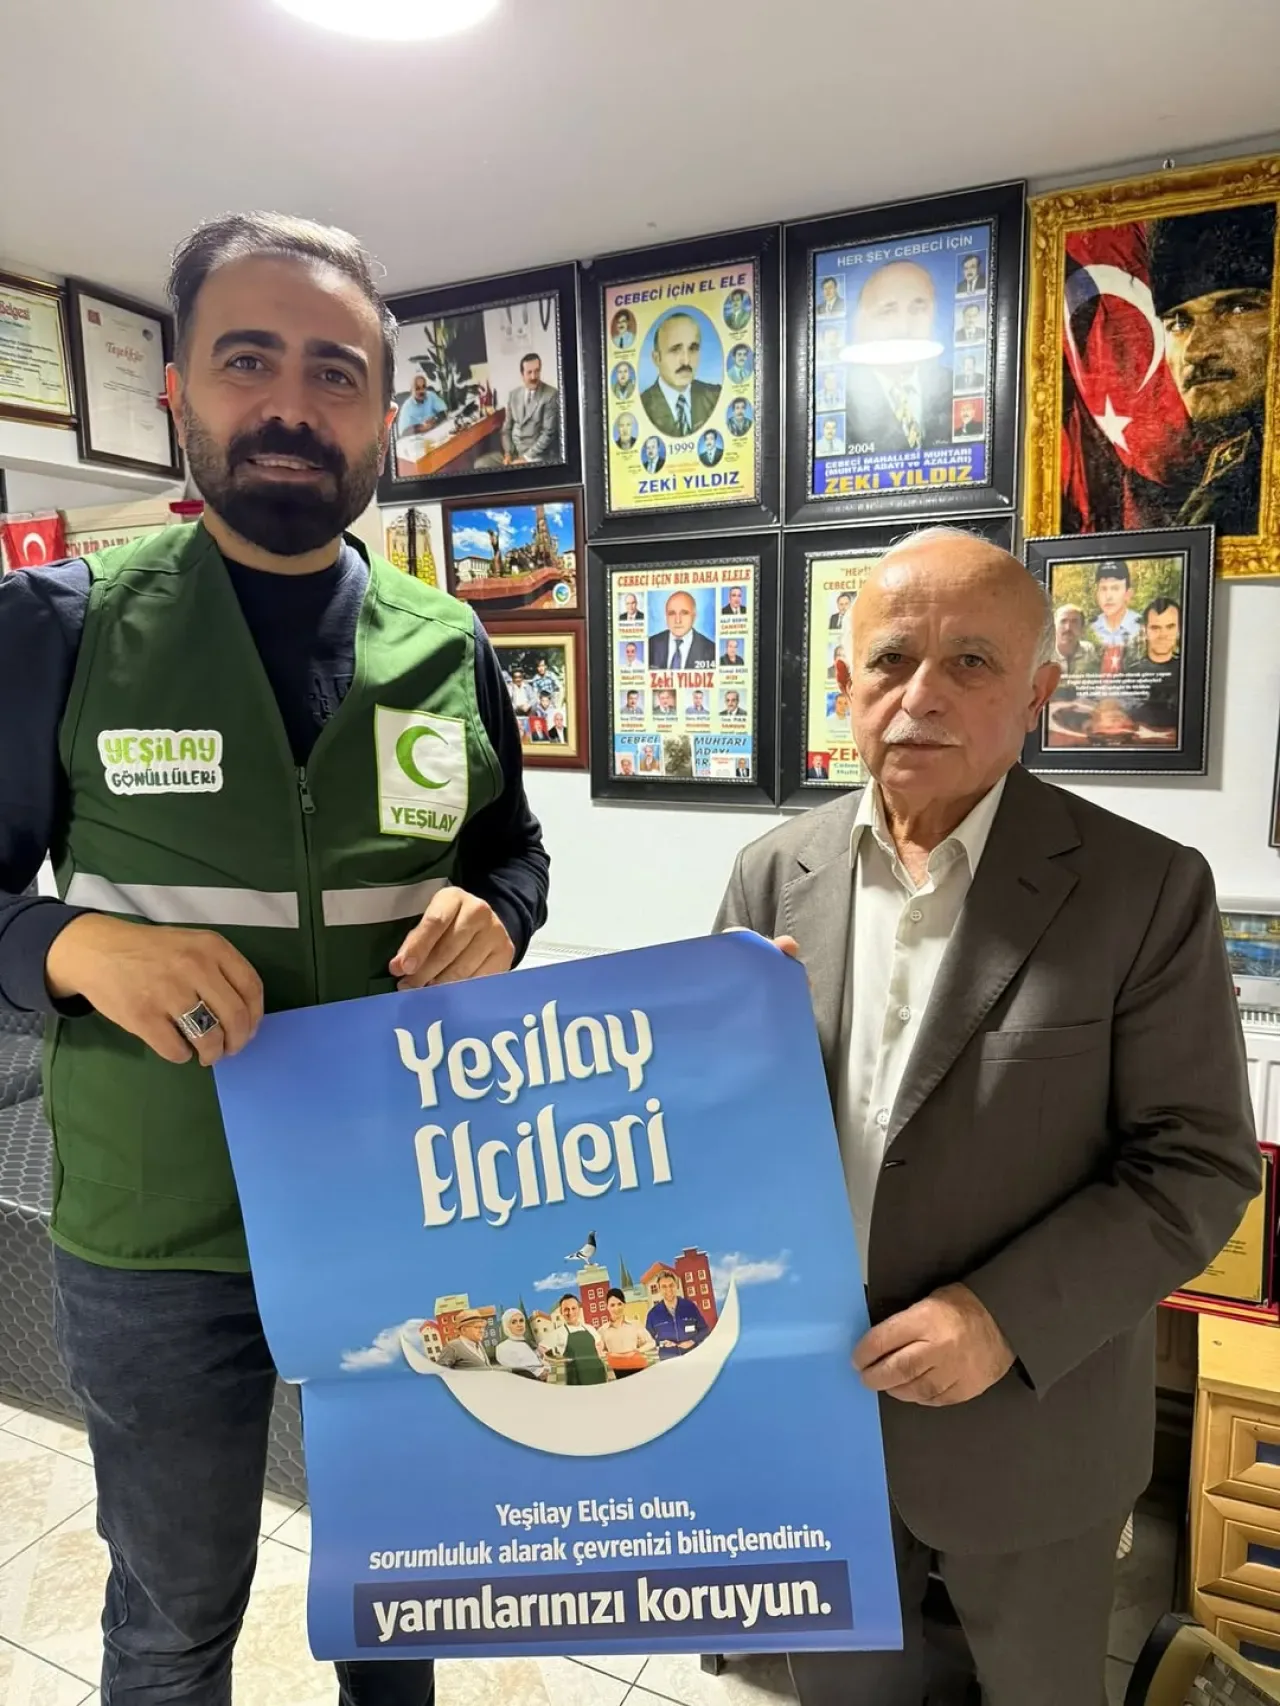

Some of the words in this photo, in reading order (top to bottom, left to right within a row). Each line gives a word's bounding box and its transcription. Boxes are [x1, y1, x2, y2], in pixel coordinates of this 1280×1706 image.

[837, 253, 864, 268] HER
[866, 248, 892, 265] ŞEY
[894, 237, 943, 259] CEBECİ
[946, 234, 973, 252] İÇİN
[614, 285, 663, 307] CEBECİ
[667, 281, 695, 301] İÇİN
[699, 279, 717, 293] EL
[720, 273, 747, 289] ELE
[668, 441, 695, 456] 1999
[848, 443, 876, 455] 2004
[825, 456, 862, 469] CEBECİ
[638, 474, 678, 495] ZEKİ
[683, 471, 741, 490] YILDIZ
[825, 473, 880, 494] ZEKİ
[888, 465, 973, 488] YILDIZ
[617, 573, 649, 588] CEBECİ
[692, 571, 719, 583] DAHA
[694, 660, 716, 669] 2014
[650, 672, 674, 688] Zeki
[677, 672, 714, 688] YILDIZ
[104, 736, 216, 768] YEŞİLAY
[828, 748, 859, 761] ZEK
[111, 768, 216, 788] GÖNÜLLÜLERİ
[390, 806, 458, 833] YEŞİLAY
[393, 999, 655, 1110] Yeşilay
[414, 1097, 673, 1228] Elçileri
[495, 1500, 573, 1531] Yeşilay
[578, 1497, 634, 1525] Elçisi
[640, 1496, 696, 1522] olun,
[369, 1540, 493, 1570] sorumluluk
[498, 1536, 566, 1564] alarak
[572, 1531, 673, 1566] çevrenizi
[677, 1523, 832, 1558] bilinçlendirin,
[372, 1584, 625, 1643] yarınlarınızı
[636, 1576, 832, 1628] koruyun.
